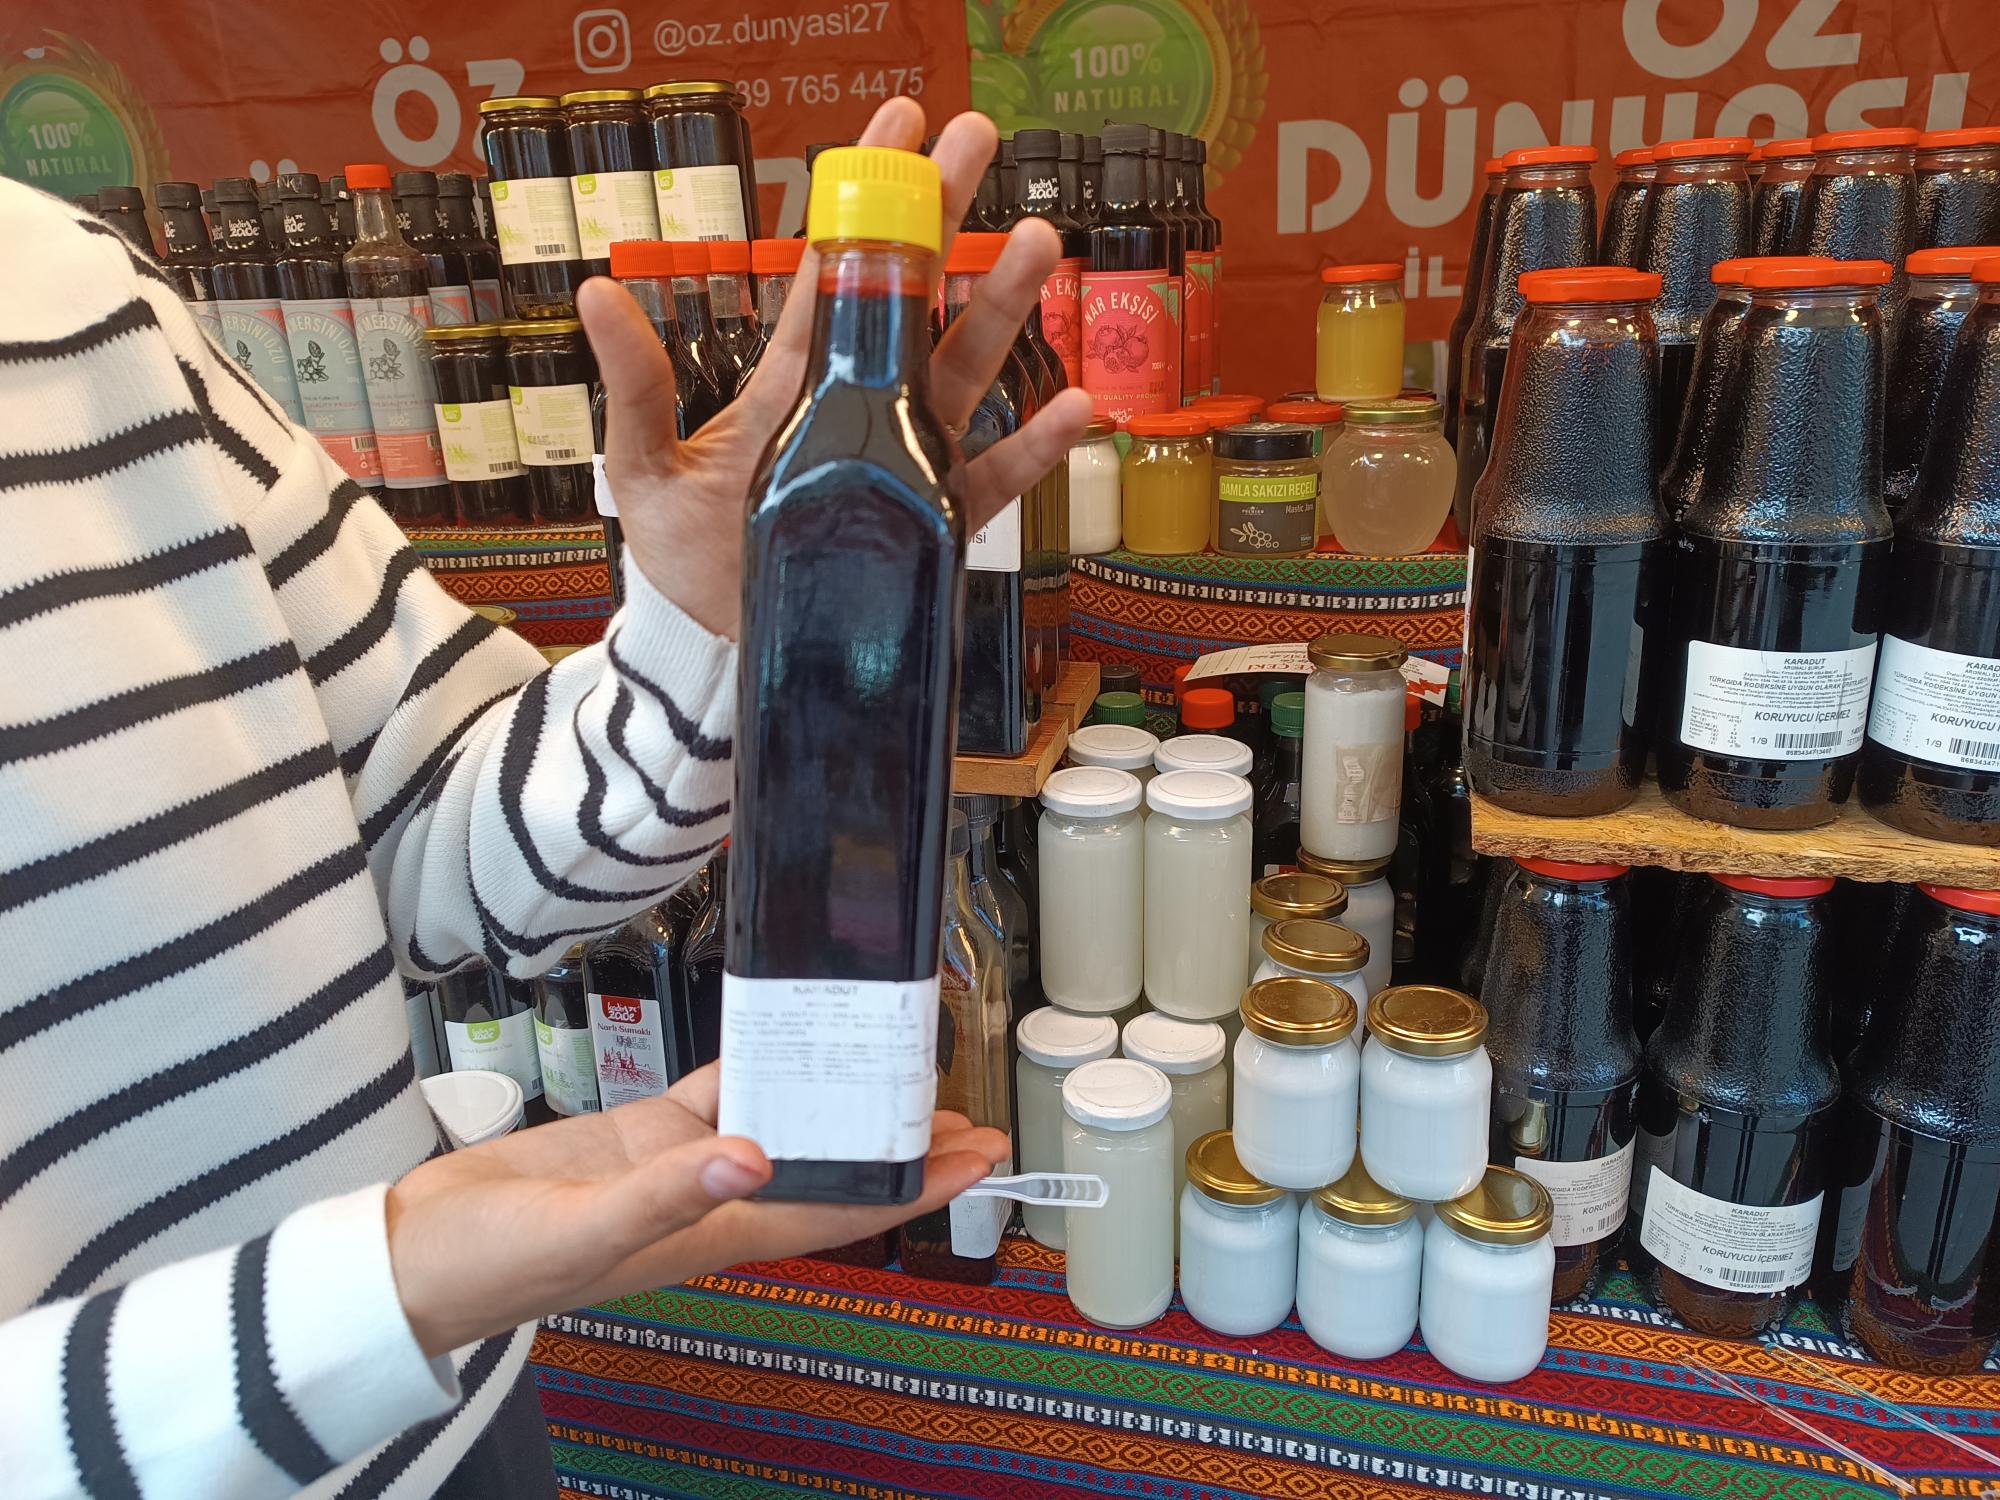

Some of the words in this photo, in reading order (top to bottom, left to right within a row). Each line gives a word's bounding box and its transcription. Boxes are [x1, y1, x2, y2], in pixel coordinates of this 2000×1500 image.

[654, 2, 890, 56] @oz.dunyasi27
[1070, 43, 1162, 79] 100%
[780, 73, 841, 105] 765
[849, 66, 924, 100] 4475
[1054, 82, 1179, 113] NATURAL
[28, 122, 95, 150] 100%
[26, 156, 112, 177] NATURAL
[1084, 296, 1106, 326] NAR
[1110, 291, 1159, 325] EKŞİSİ
[1220, 481, 1251, 497] DAMLA
[1252, 483, 1287, 498] SAKIZI
[1285, 503, 1303, 515] Mastic
[1783, 657, 1827, 665] KARADUT
[1966, 661, 2000, 672] KARAD
[1744, 680, 1787, 691] KODEKSİNE
[1788, 683, 1814, 691] UYGUN
[1814, 682, 1842, 691] OLARAK
[1923, 680, 1967, 695] KODEKSİNE
[1967, 688, 1997, 699] UYGUN
[1754, 710, 1814, 723] KORUYUCU
[1814, 708, 1851, 725] İÇERMEZ
[1930, 712, 1996, 732] KORUYUCU
[1750, 736, 1768, 745] 1/9
[1925, 738, 1942, 748] 1/9
[1582, 1198, 1620, 1215] KORUYUCU
[1731, 1208, 1771, 1217] KARADUT
[1694, 1217, 1733, 1235] KODEKSİNE
[1733, 1229, 1758, 1238] UYGUN
[1758, 1230, 1784, 1238] OLARAK
[1702, 1245, 1757, 1262] KORUYUCU
[1757, 1251, 1794, 1264] İÇERMEZ
